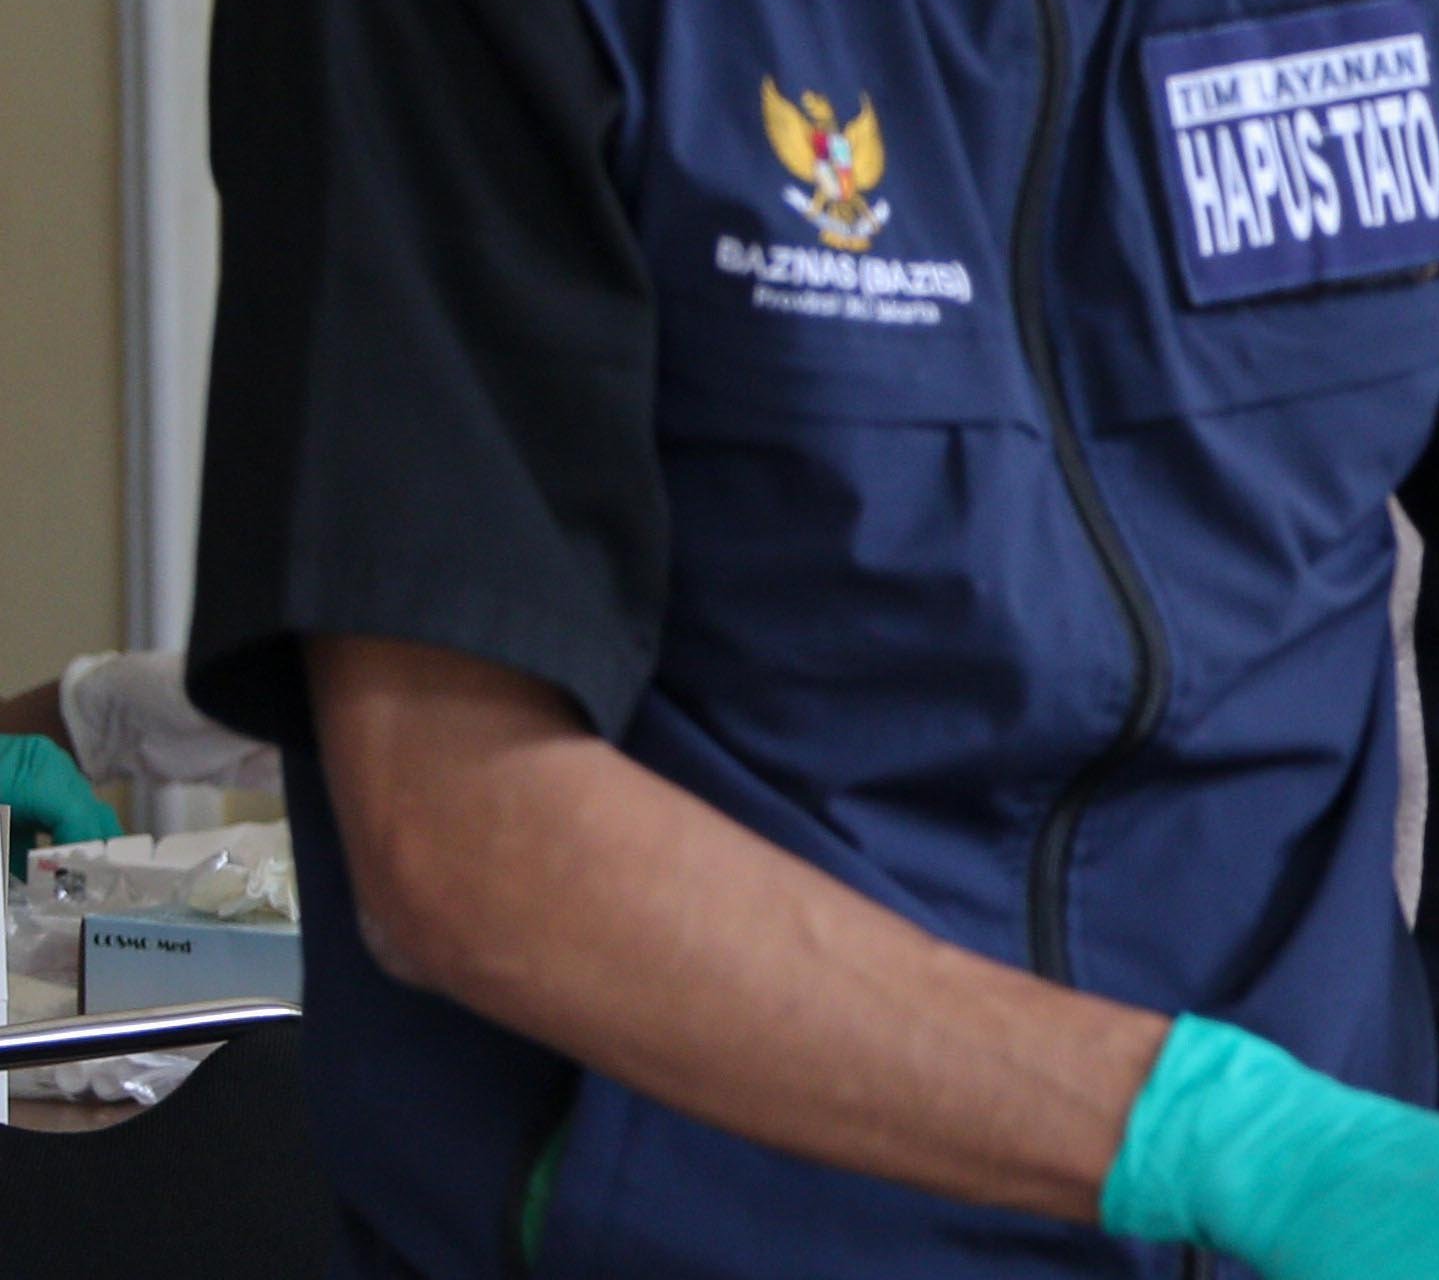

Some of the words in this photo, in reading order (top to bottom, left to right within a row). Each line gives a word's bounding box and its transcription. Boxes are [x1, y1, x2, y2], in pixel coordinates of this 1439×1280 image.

[1178, 75, 1241, 117] TIM
[1175, 107, 1342, 257] HAPUS
[715, 234, 858, 290] BAZNAS
